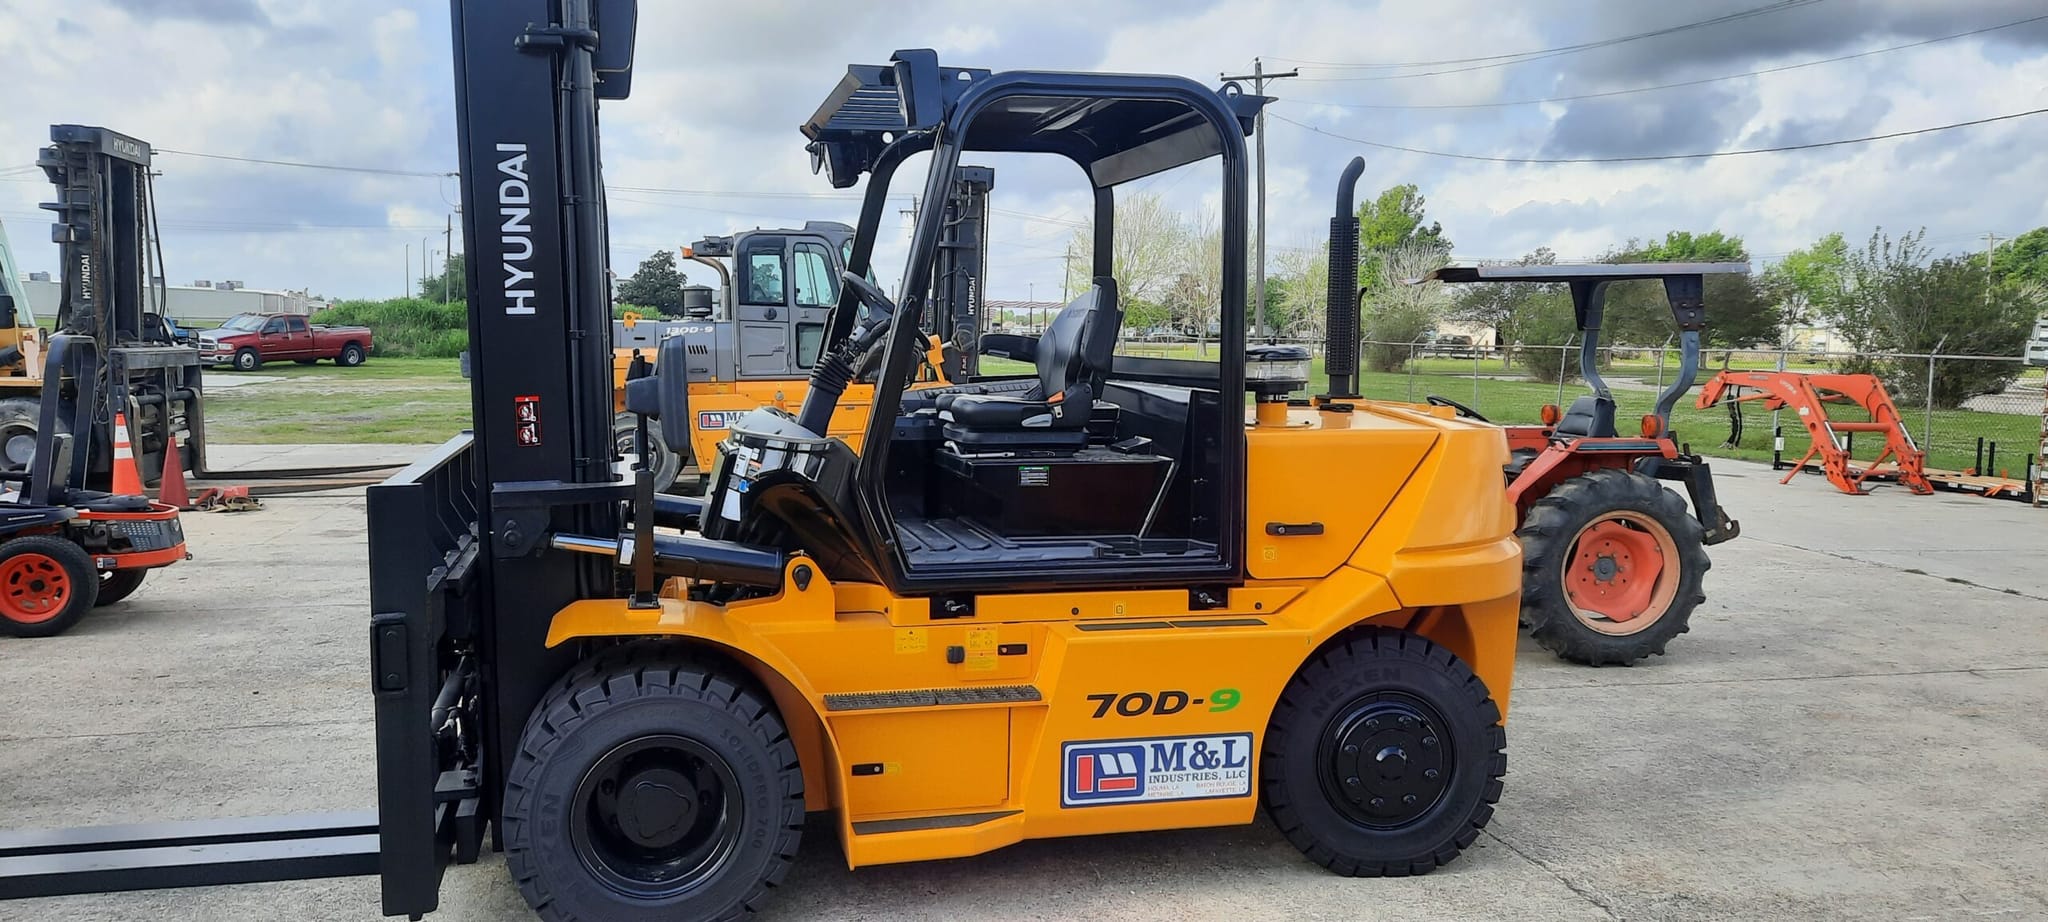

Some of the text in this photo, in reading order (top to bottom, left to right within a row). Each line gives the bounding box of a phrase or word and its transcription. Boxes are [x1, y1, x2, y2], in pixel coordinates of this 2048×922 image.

[113, 137, 141, 158] HYUNDAI
[496, 143, 536, 316] HYUNDAI
[81, 254, 91, 300] HYUNDAI
[967, 277, 976, 315] HYUNDAI
[1086, 688, 1242, 719] 70D-9
[1311, 667, 1401, 718] NEXEN
[1150, 739, 1248, 773] M&L
[1148, 770, 1247, 784] INDUSTRIES, LLC
